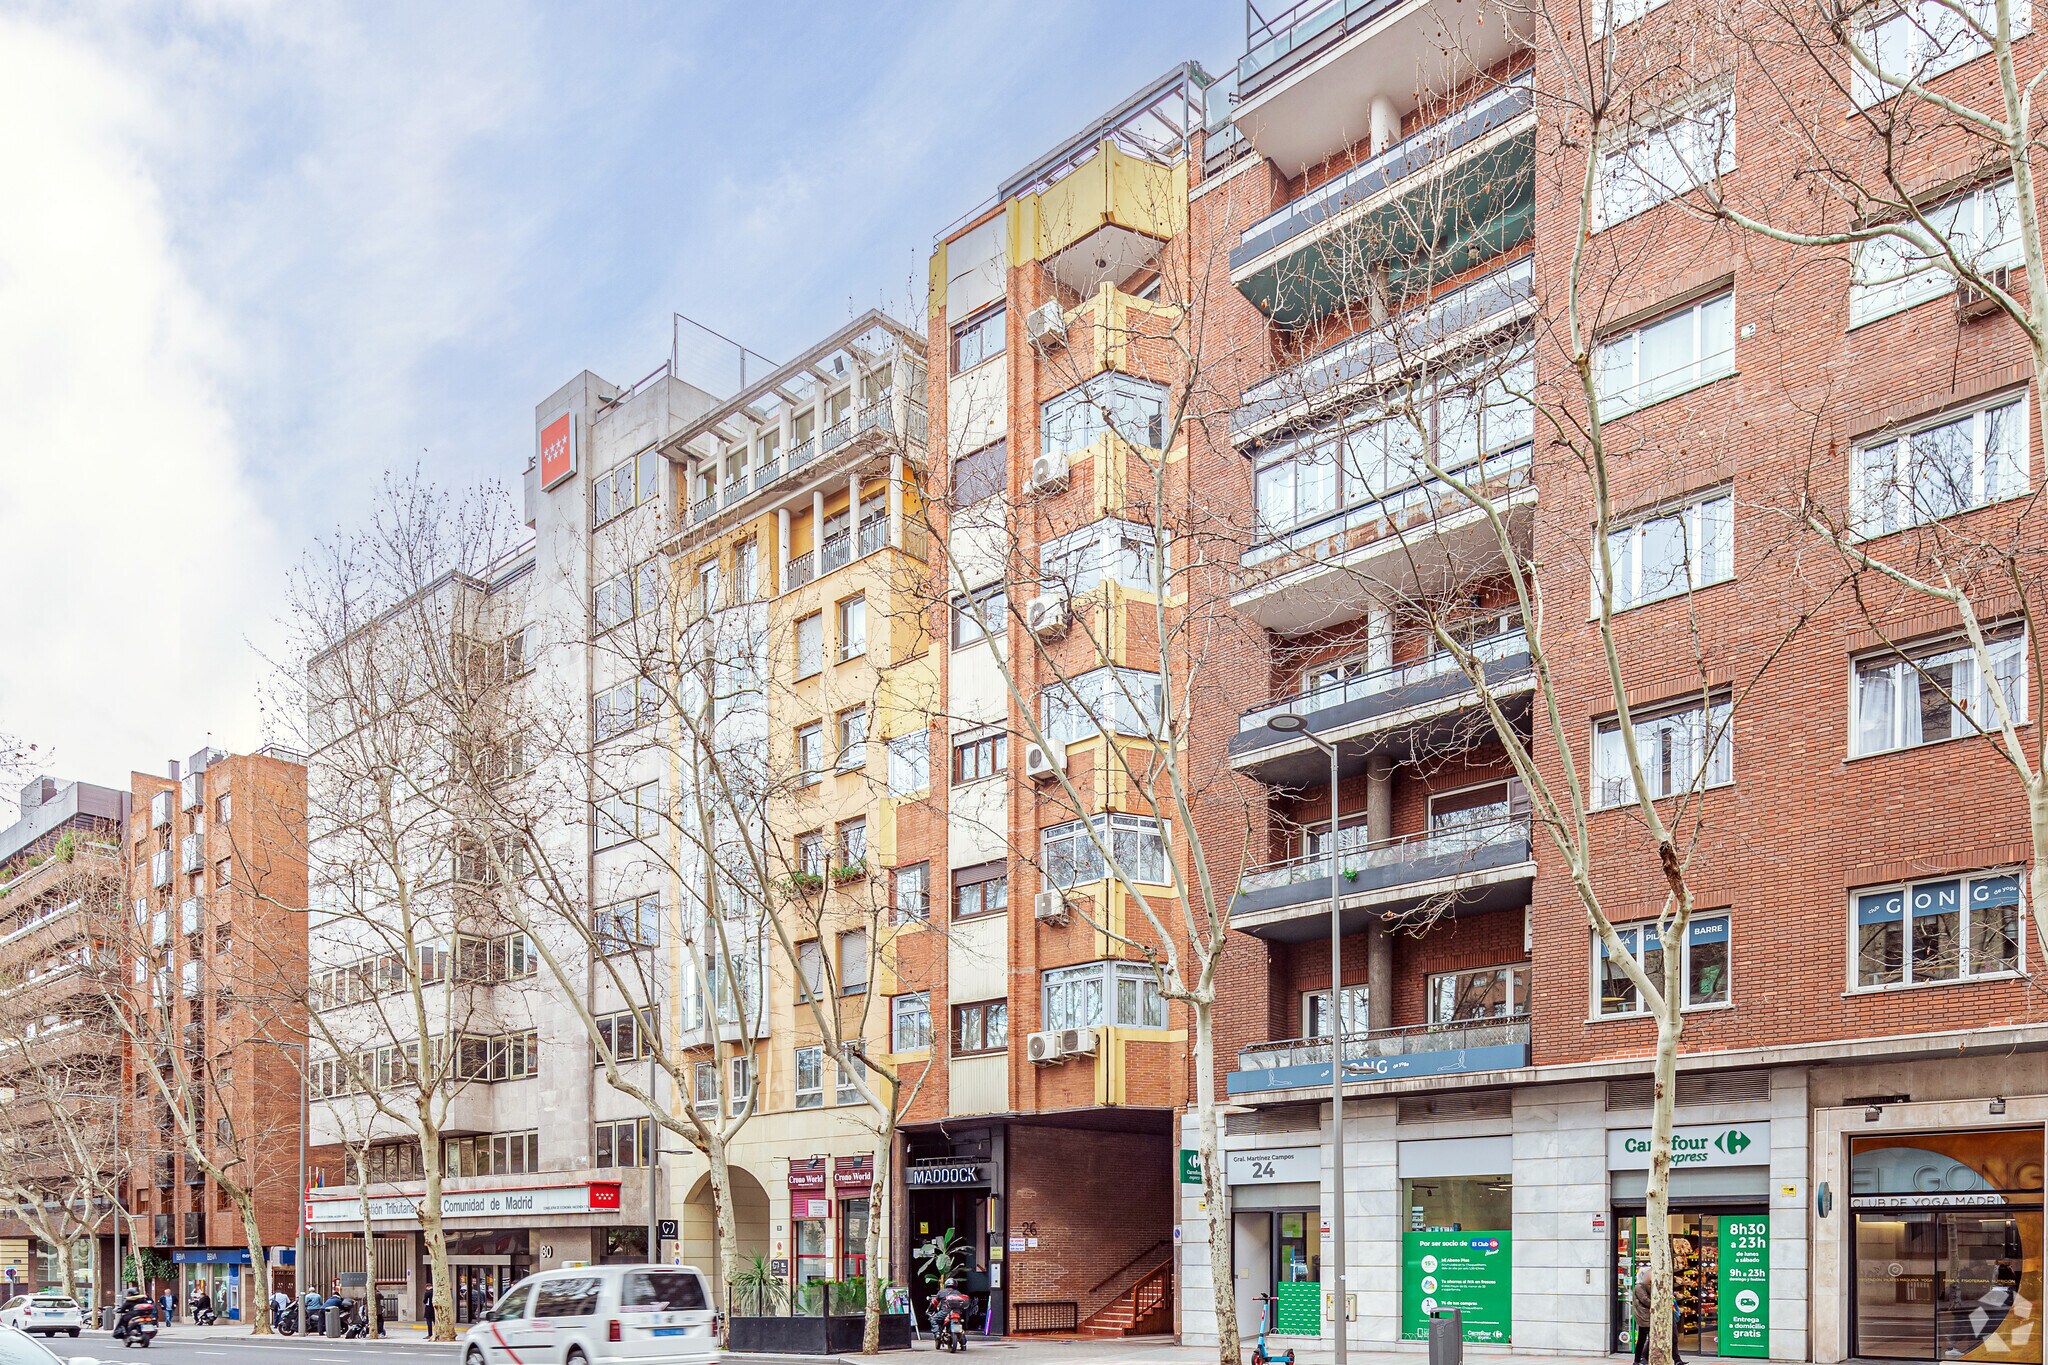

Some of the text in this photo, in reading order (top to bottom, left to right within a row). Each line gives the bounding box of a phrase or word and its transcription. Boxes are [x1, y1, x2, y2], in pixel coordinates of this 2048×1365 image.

[1886, 885, 1989, 914] GONG
[1694, 924, 1723, 935] BARRE
[1624, 1135, 1709, 1153] Carfour
[1670, 1152, 1709, 1166] xpress
[1252, 1161, 1275, 1178] 24
[806, 1174, 823, 1183] World
[834, 1173, 852, 1182] Crono
[852, 1171, 871, 1180] World
[913, 1167, 977, 1185] MADDOCK
[1913, 1162, 2043, 1193] GONG
[444, 1198, 485, 1212] Comunidad
[490, 1197, 500, 1211] de
[505, 1196, 533, 1210] Madrid
[1852, 1195, 2010, 1207] CLUB DE YOGA MADRID
[1022, 1221, 1037, 1236] 26
[1730, 1223, 1766, 1235] 8h30
[1739, 1236, 1766, 1248] 23h
[176, 1253, 186, 1261] BBVA
[206, 1253, 217, 1261] BBVA
[1730, 1269, 1742, 1277] 9h
[1748, 1269, 1766, 1277] 23h
[1733, 1330, 1761, 1338] gratis
